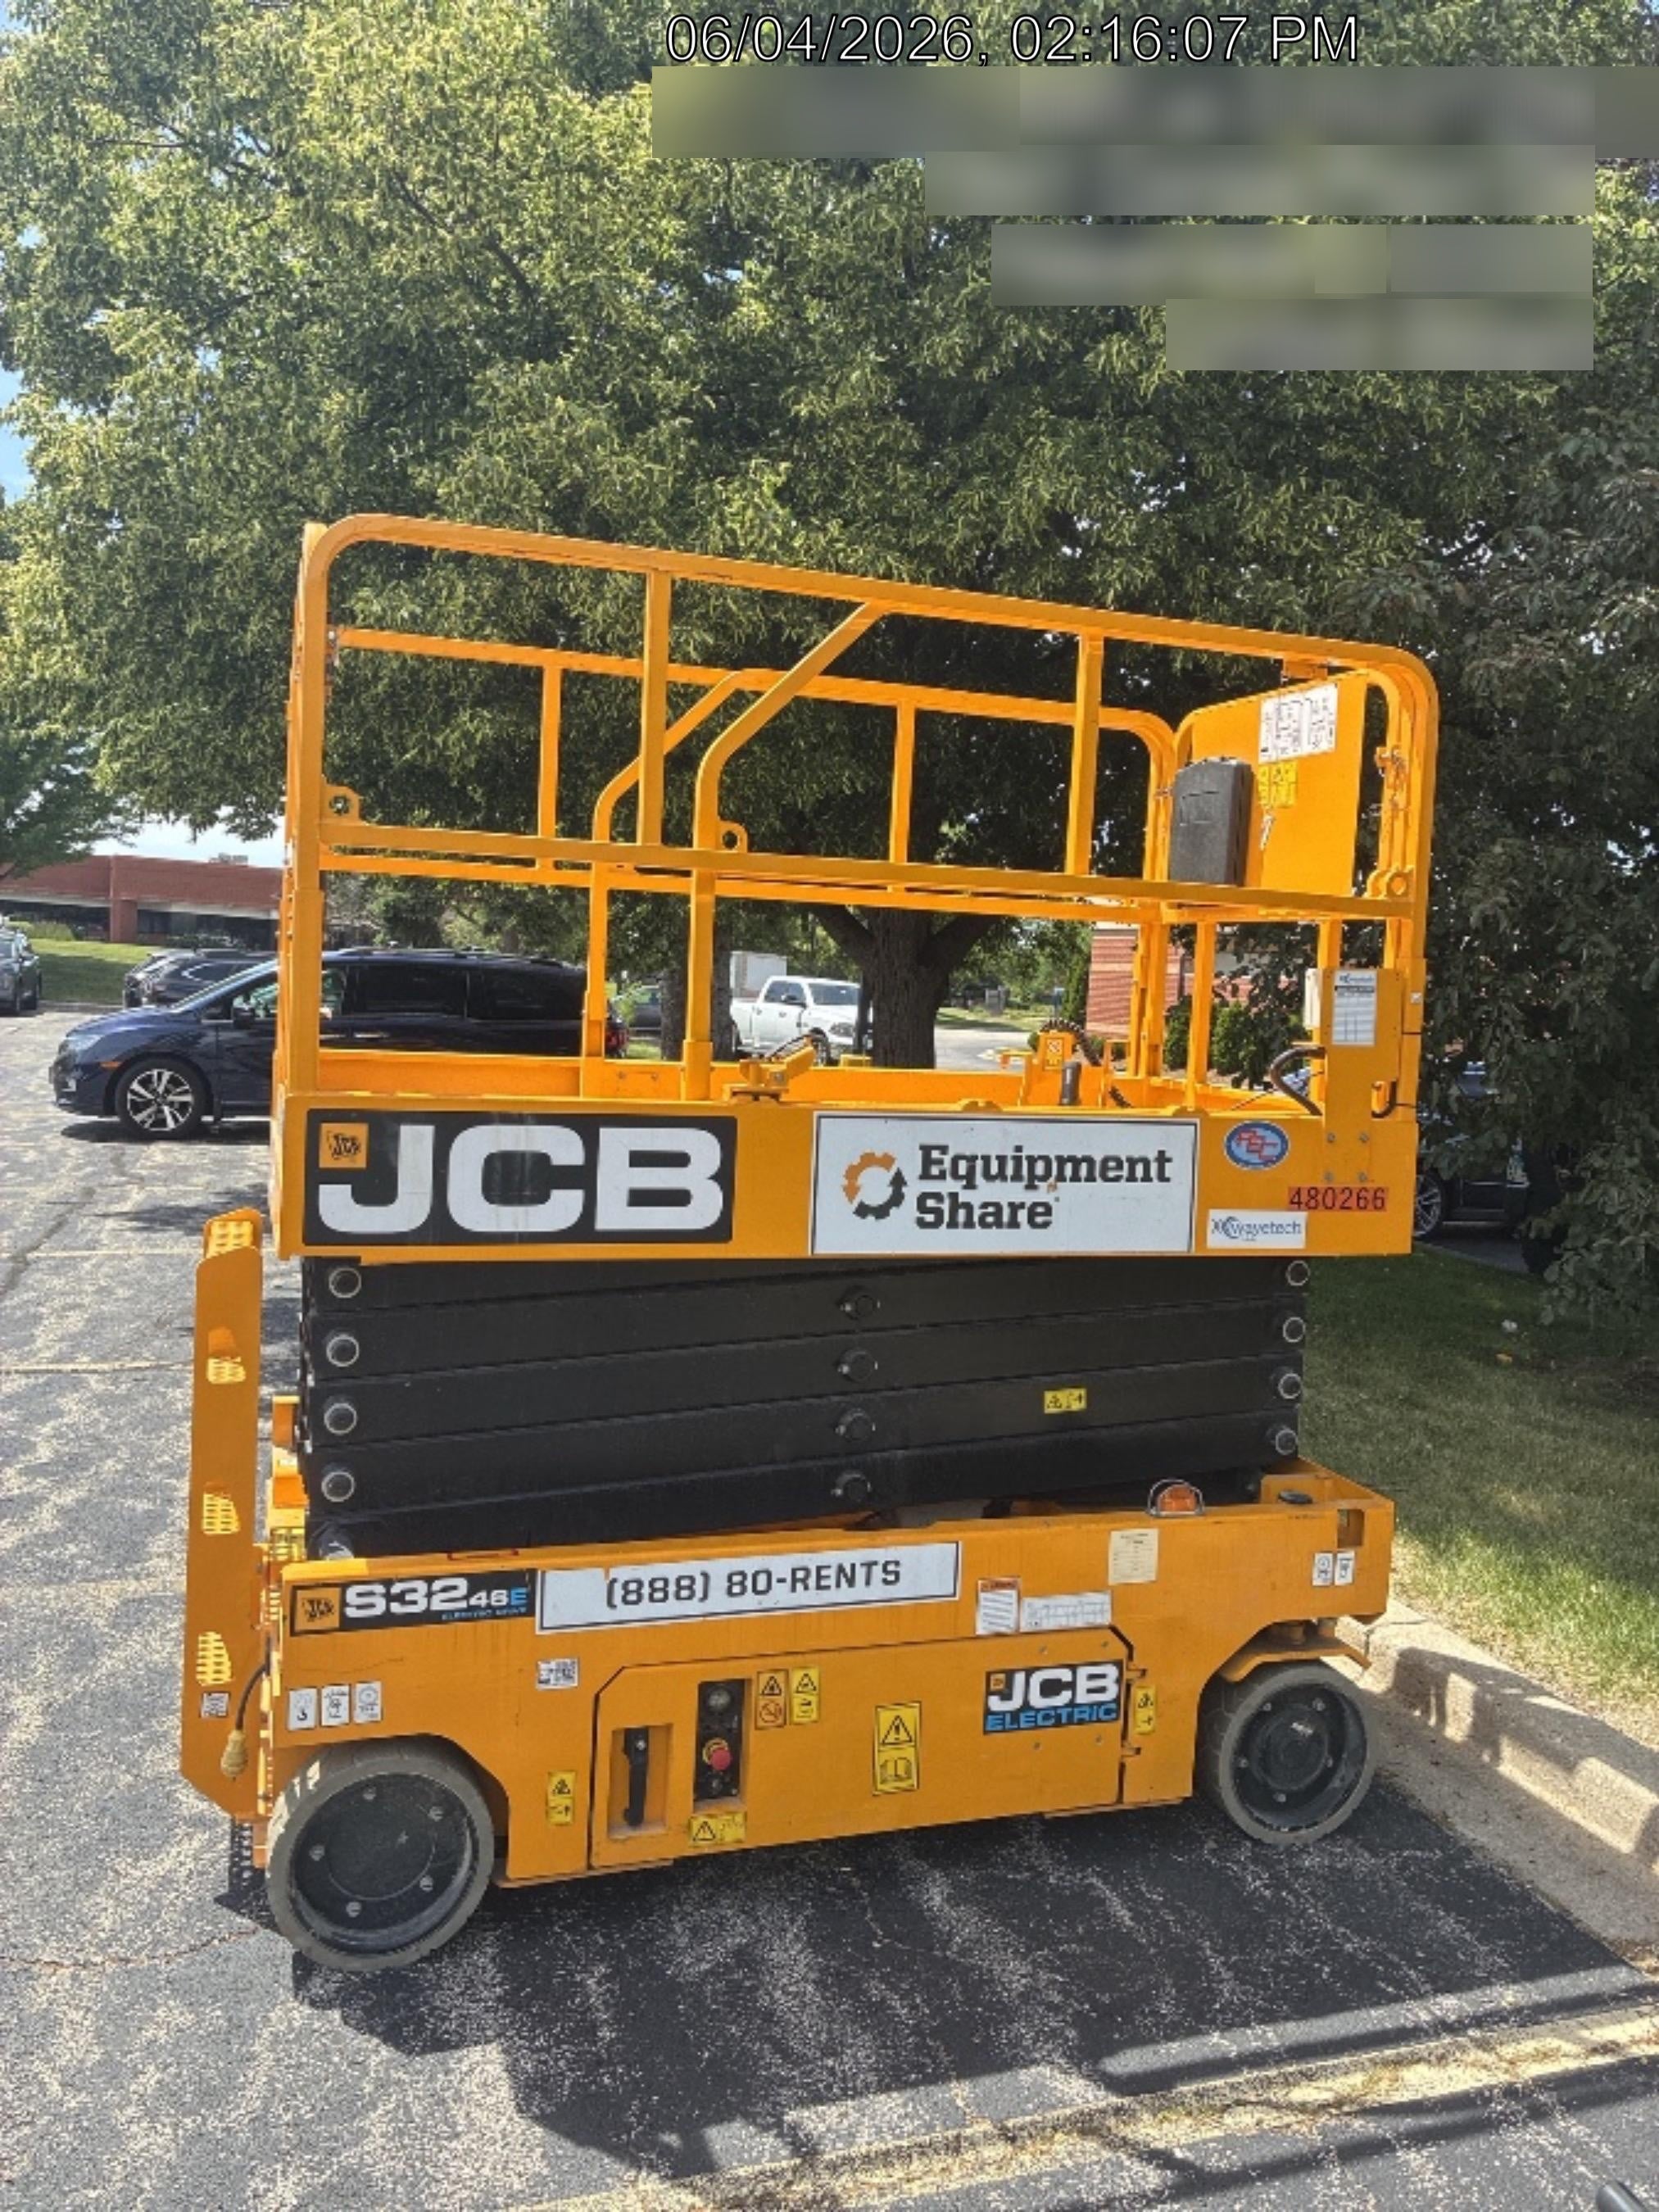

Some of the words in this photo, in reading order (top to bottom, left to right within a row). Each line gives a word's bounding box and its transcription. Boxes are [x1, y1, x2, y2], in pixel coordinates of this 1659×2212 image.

[318, 1124, 723, 1234] JCB
[918, 1144, 1172, 1190] Equipment
[915, 1191, 1054, 1230] Share
[1289, 1186, 1386, 1210] 480266
[606, 1570, 710, 1609] (888)
[726, 1559, 902, 1598] 80-RENTS
[987, 1662, 1120, 1712] JCB
[985, 1702, 1117, 1732] ELECTRIC
